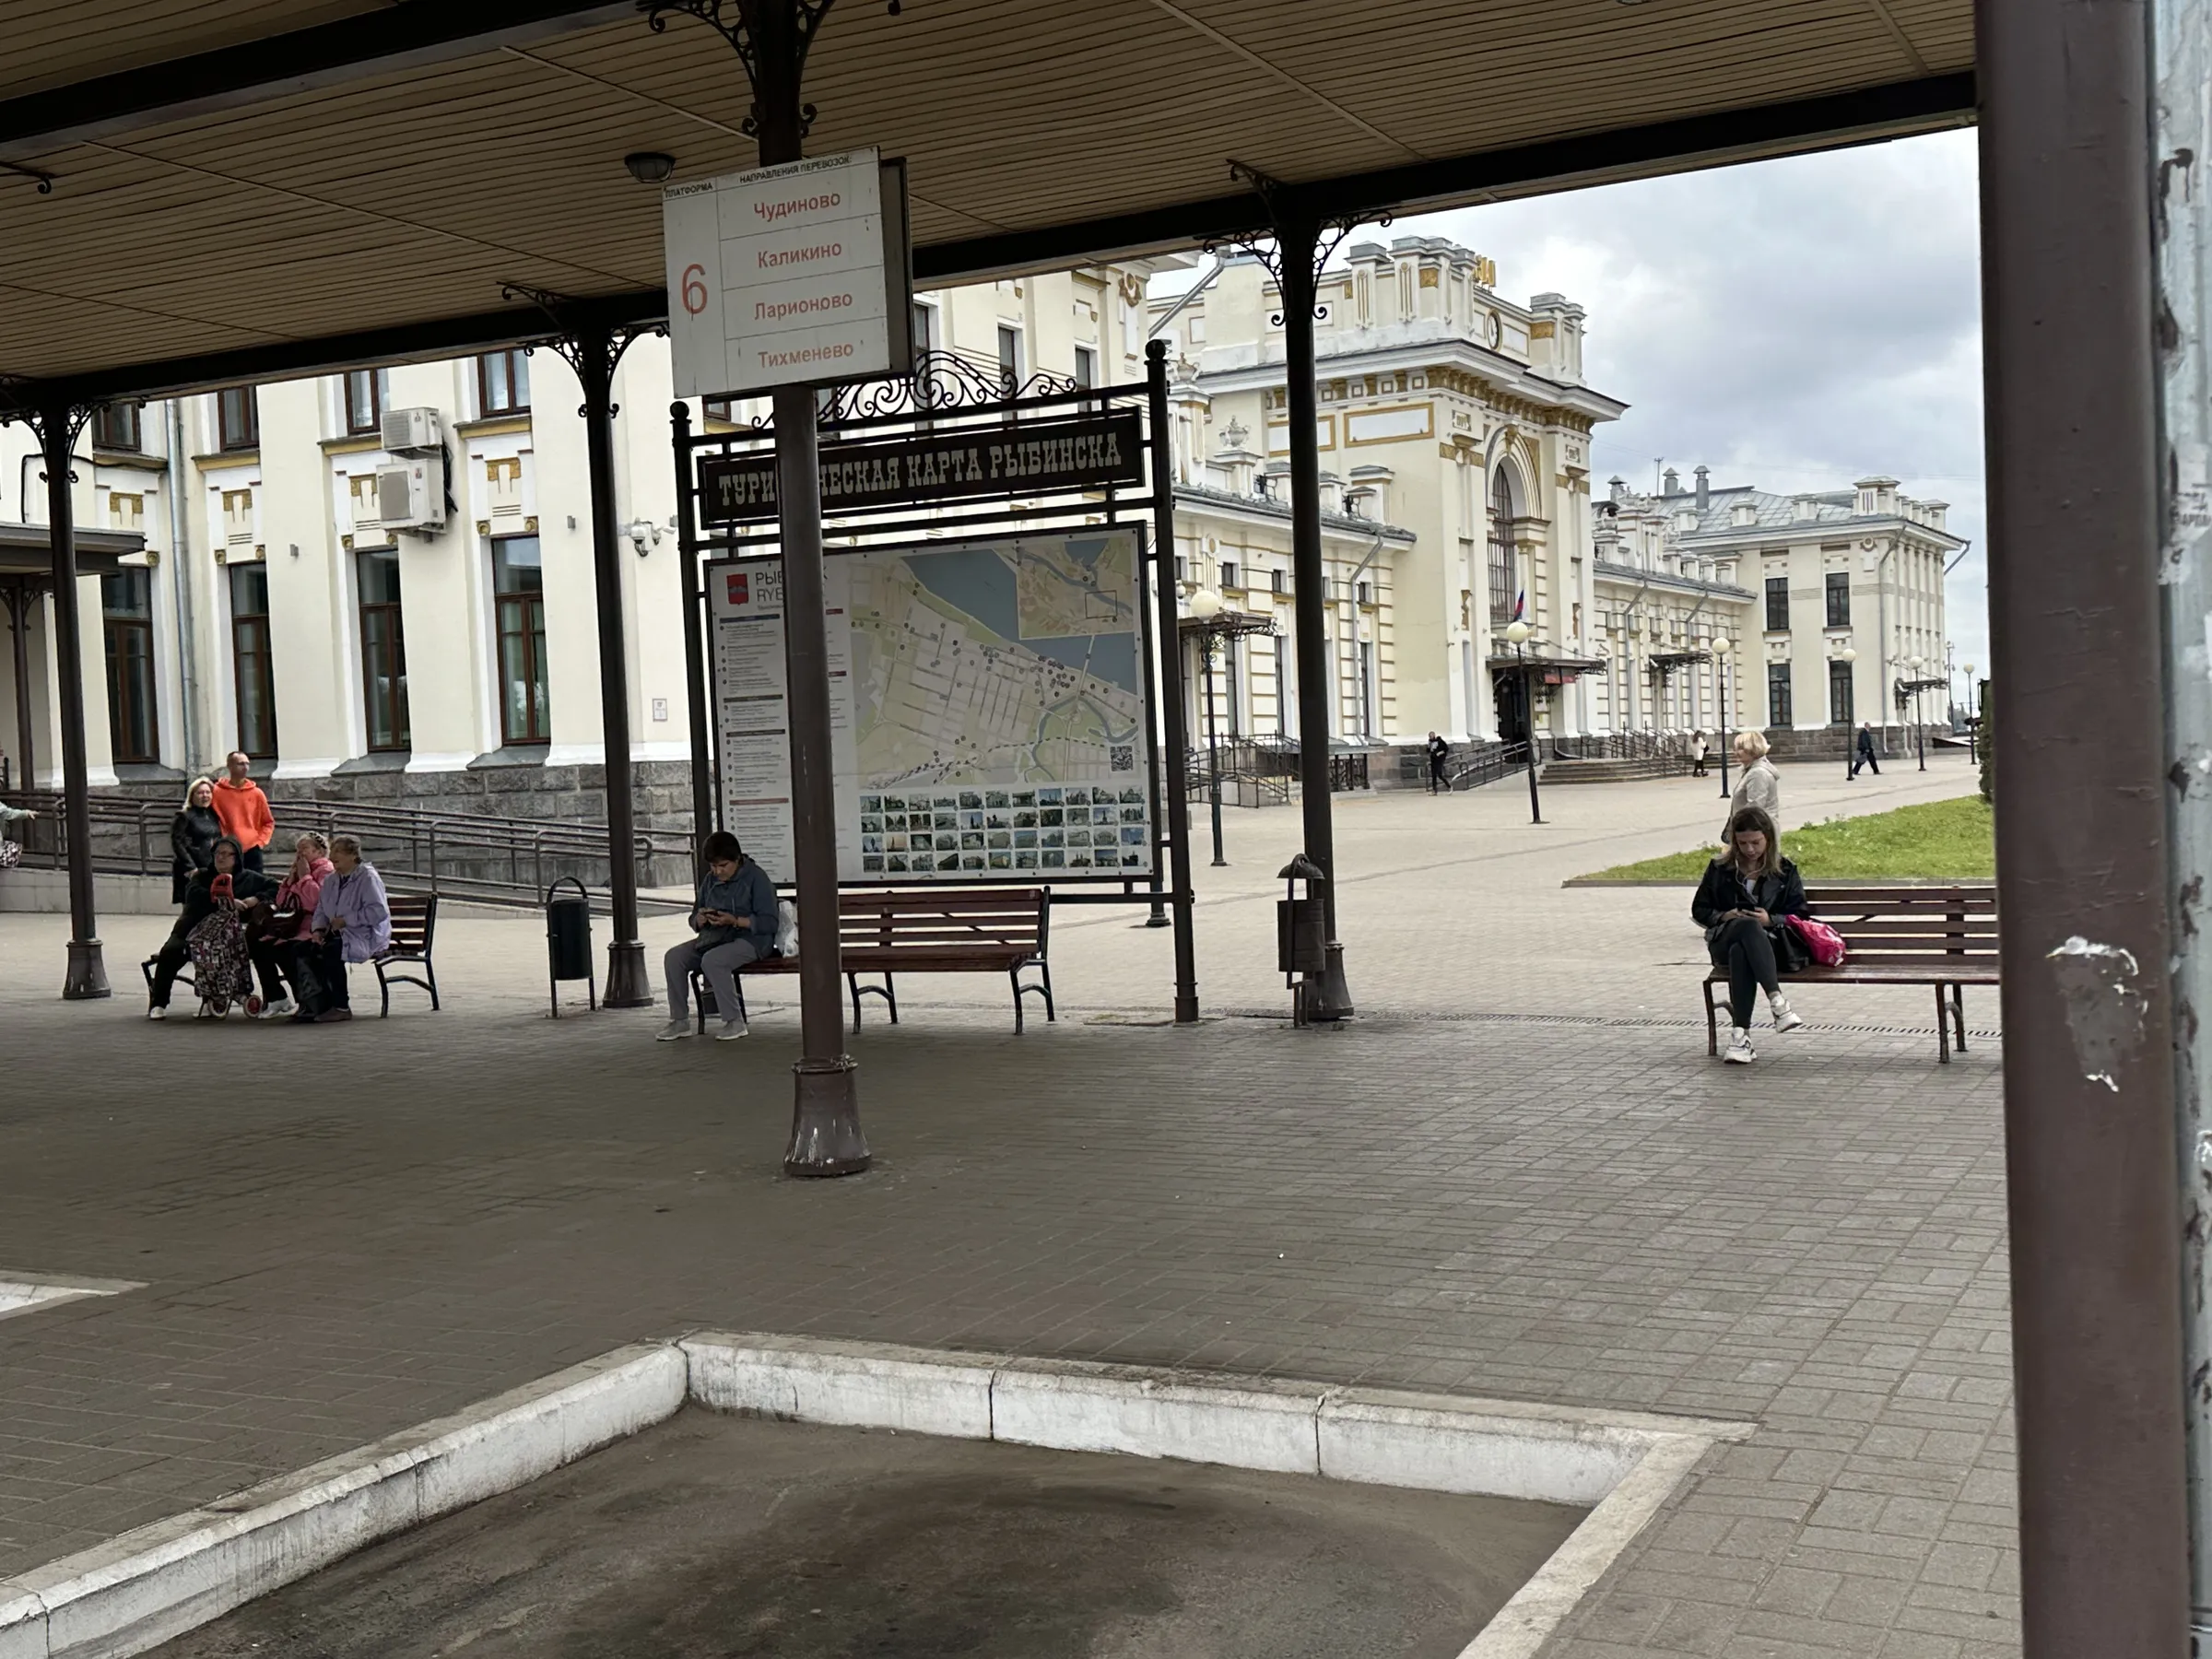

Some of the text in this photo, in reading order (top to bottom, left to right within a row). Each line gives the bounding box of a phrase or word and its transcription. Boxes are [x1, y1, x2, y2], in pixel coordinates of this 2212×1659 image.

[740, 164, 799, 184] НАПРАВЛЕНИЯ
[665, 182, 713, 199] ПЛАТФОРМА
[753, 192, 841, 223] Чудиново
[757, 241, 842, 269] Каликино
[681, 263, 709, 315] 6
[753, 292, 853, 322] Ларионово
[757, 342, 854, 370] Тихменево
[907, 448, 983, 488] КАРТА
[989, 432, 1122, 479] РЫБИНСКА
